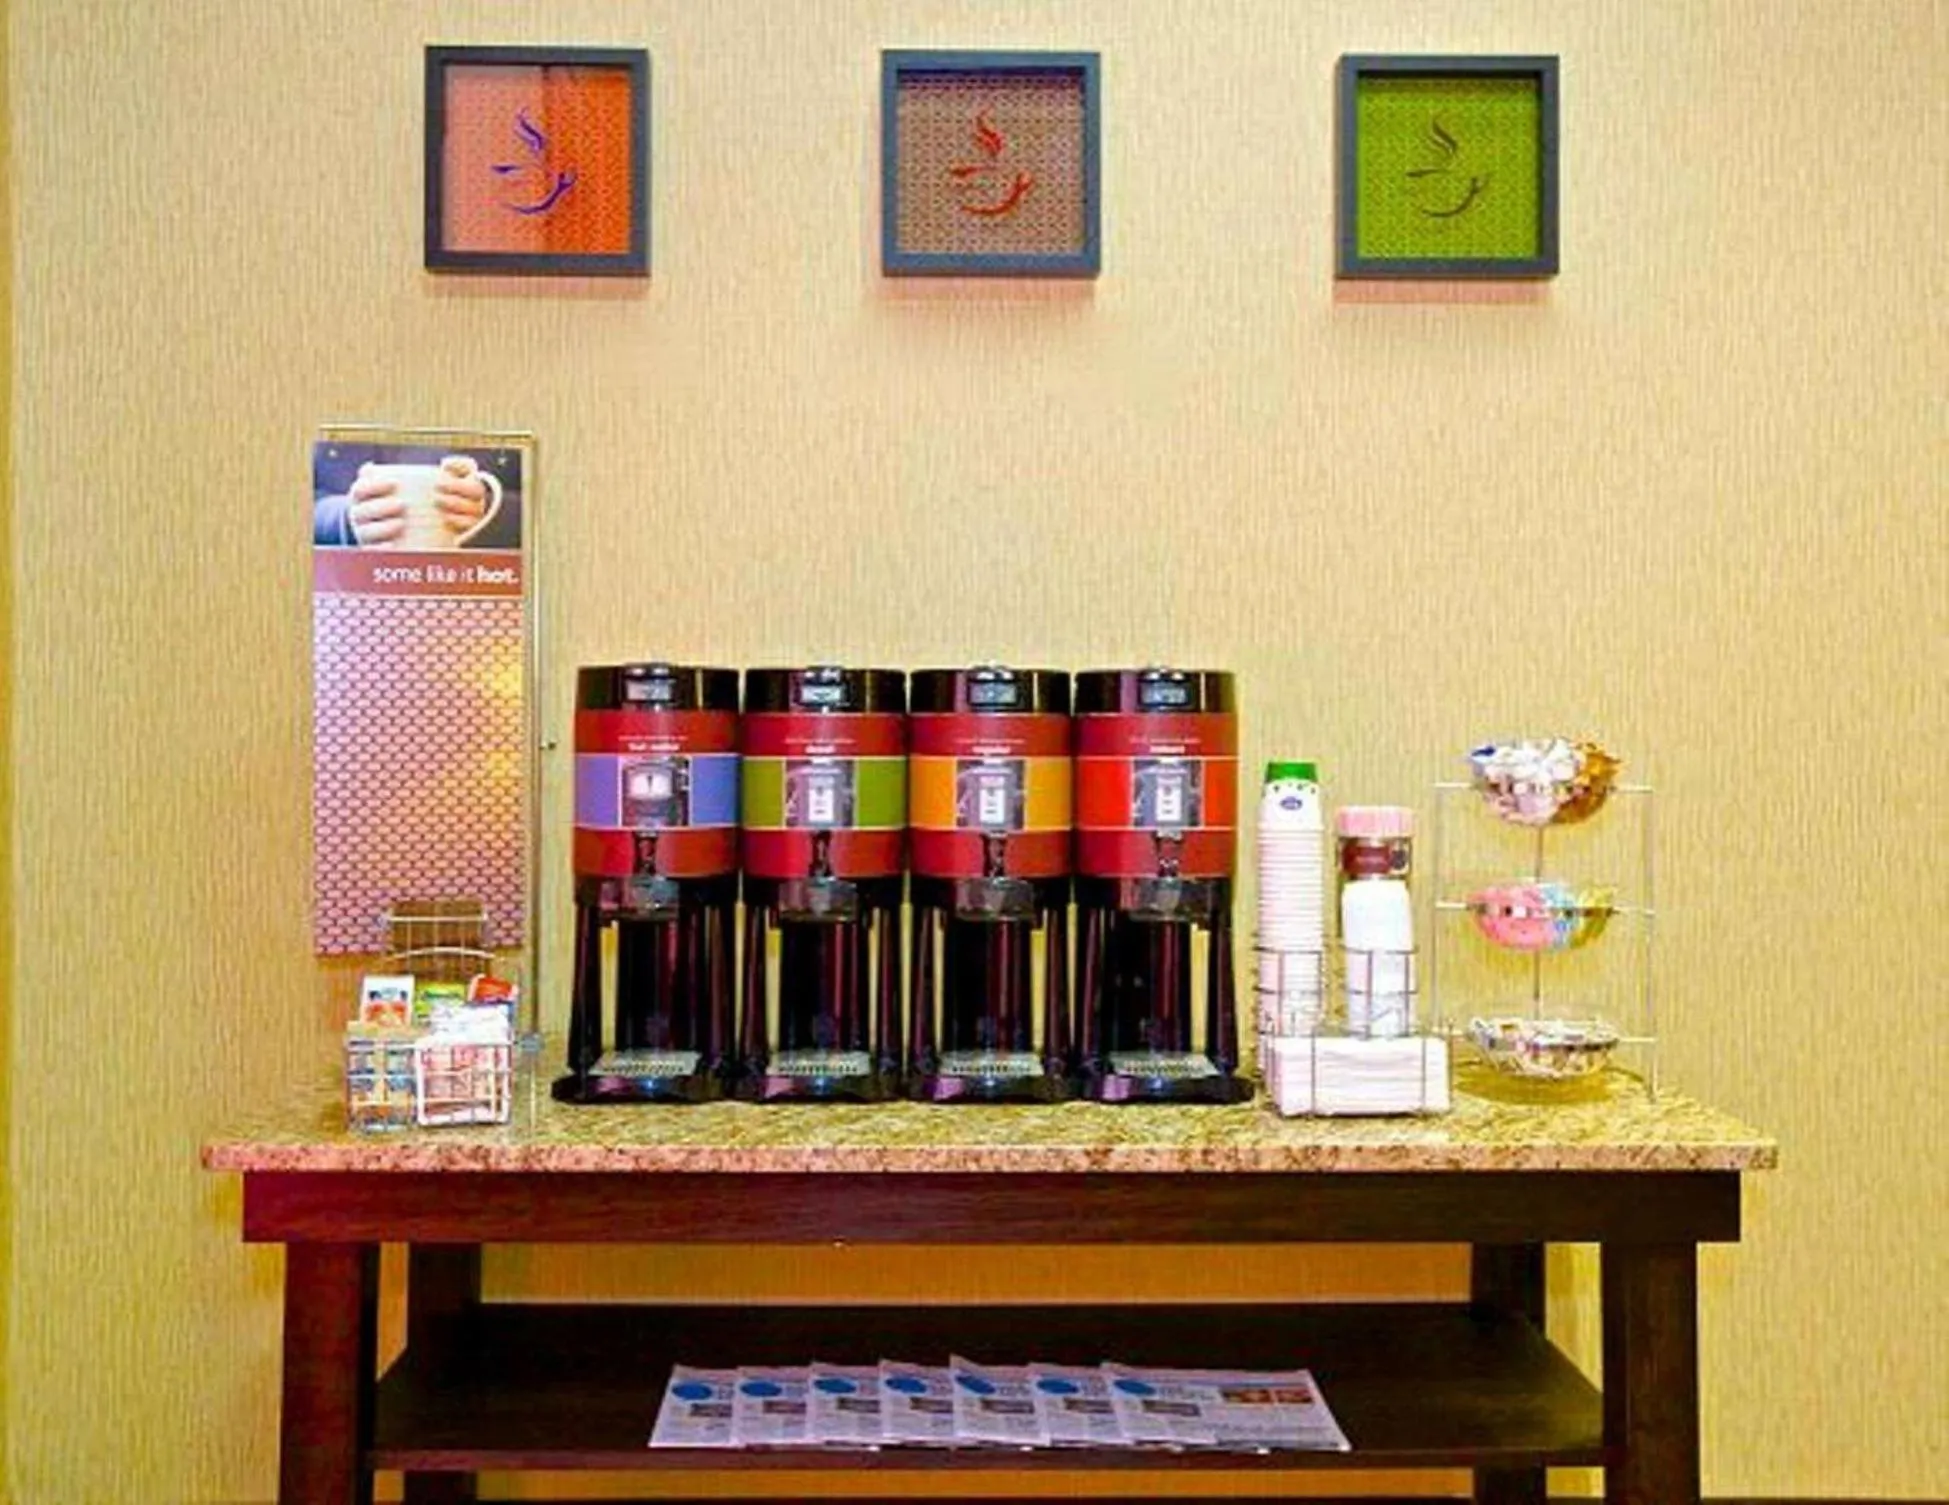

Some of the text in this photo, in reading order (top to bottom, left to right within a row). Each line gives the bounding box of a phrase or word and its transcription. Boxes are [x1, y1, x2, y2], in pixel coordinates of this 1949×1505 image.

[373, 564, 519, 584] some like it hot.
